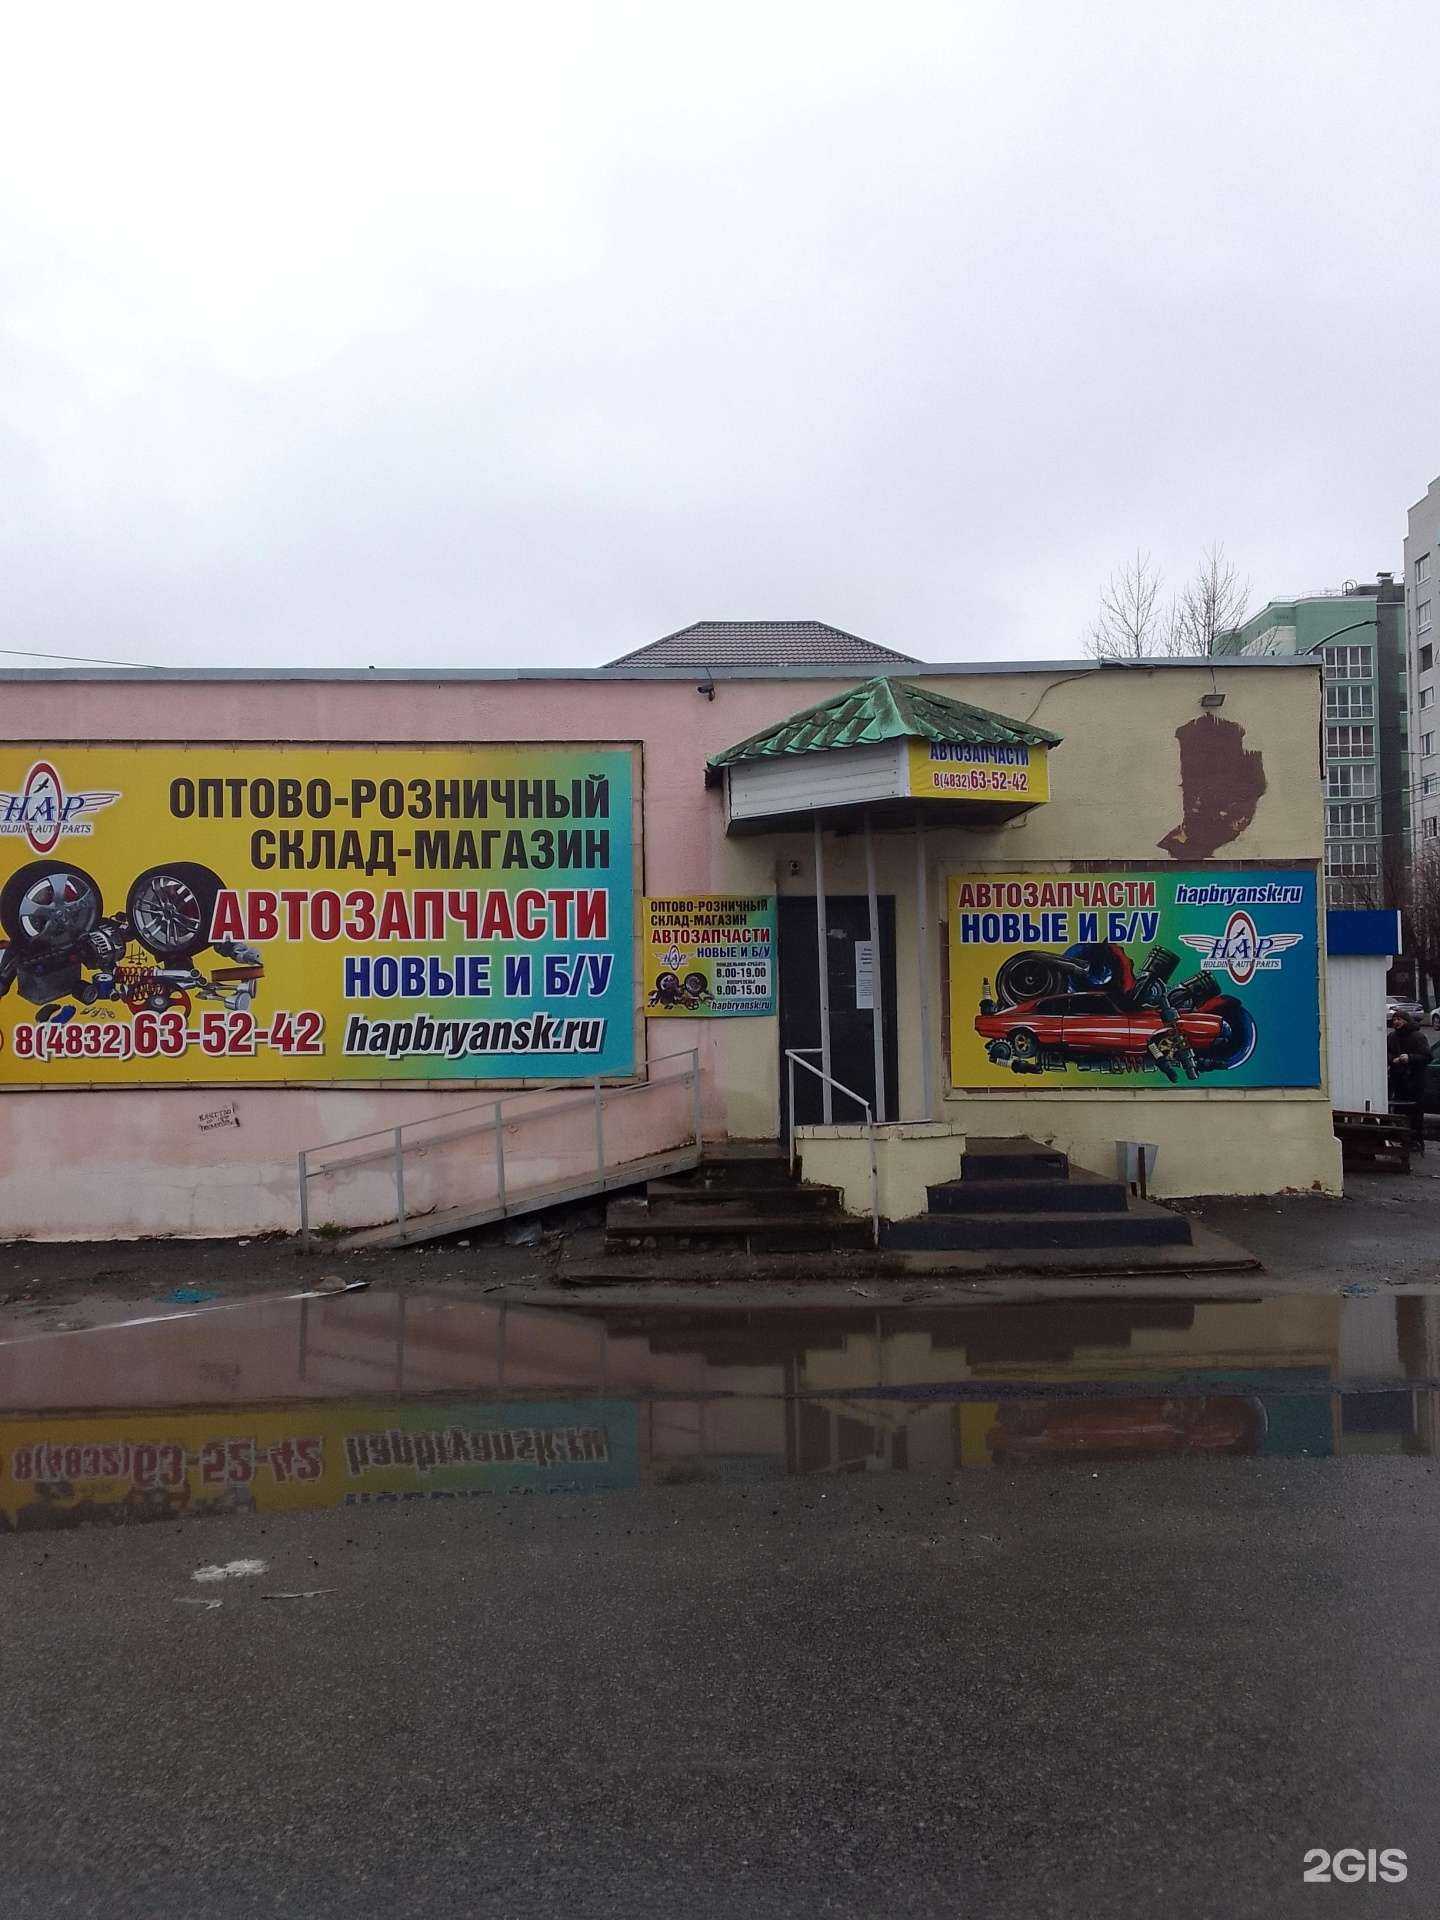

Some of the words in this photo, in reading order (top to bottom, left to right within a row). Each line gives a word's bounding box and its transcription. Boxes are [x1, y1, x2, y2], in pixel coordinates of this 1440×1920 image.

[929, 741, 1030, 766] АВТОЗАПЧАСТИ
[933, 770, 1028, 791] 8(4832)63-52-42
[3, 796, 86, 822] HAP
[169, 774, 610, 820] ОПТОВО-РОЗНИЧНЫЙ
[0, 824, 33, 834] OLDING
[61, 824, 92, 834] PARTS
[250, 828, 610, 877] СКЛАД-МАГАЗИН
[650, 899, 768, 912] ОПТОВО-РОЗНИЧНЫЙ
[958, 881, 1157, 908] АВТОЗАПЧАСТИ
[1175, 883, 1303, 906] hapbryansk.ru
[208, 888, 610, 942] АВТОЗАПЧАСТИ
[650, 914, 747, 928] СКЛАД-МАГАЗИН
[960, 911, 1069, 944] НОВЫЕ
[1078, 911, 1099, 944] И
[1107, 910, 1160, 944] Б/У
[651, 928, 771, 944] АВТОЗАПЧАСТИ
[697, 947, 737, 958] НОВЫЕ
[740, 947, 748, 957] И
[751, 946, 770, 958] Б/У
[1211, 938, 1274, 959] HAP
[343, 956, 491, 998] НОВЫЕ
[505, 956, 532, 998] И
[545, 953, 613, 998] Б/У
[716, 968, 767, 978] 8.00-19.00
[716, 985, 767, 995] 9.00-15.00
[13, 1010, 324, 1060] 8(4832)63-52-42
[345, 1012, 604, 1059] hapbryansk.ru
